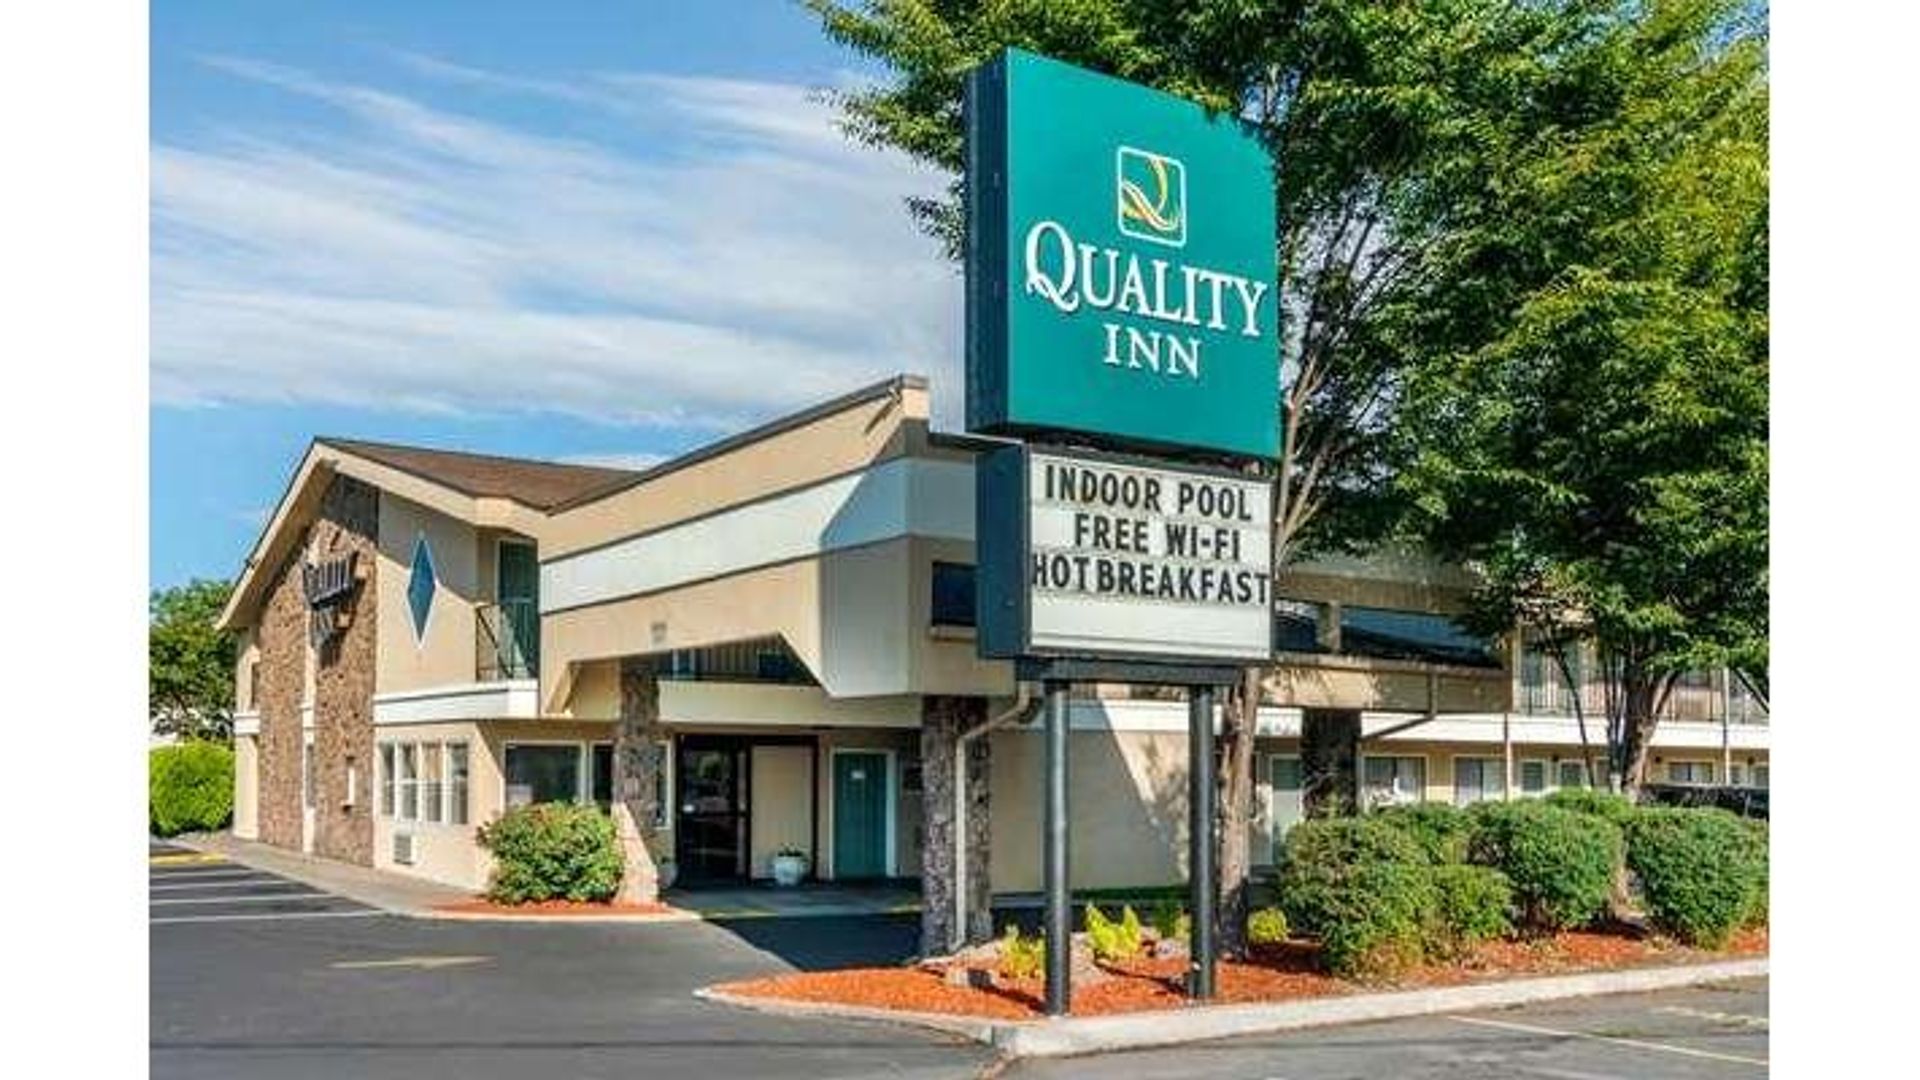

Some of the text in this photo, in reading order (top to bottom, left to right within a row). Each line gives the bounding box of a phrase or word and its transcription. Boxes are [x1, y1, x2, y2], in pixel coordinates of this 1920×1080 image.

[1025, 220, 1267, 336] QUALITY
[1103, 322, 1201, 378] INN
[1045, 465, 1252, 521] INDOOR POOL
[1074, 513, 1240, 562] FREE WI-FI
